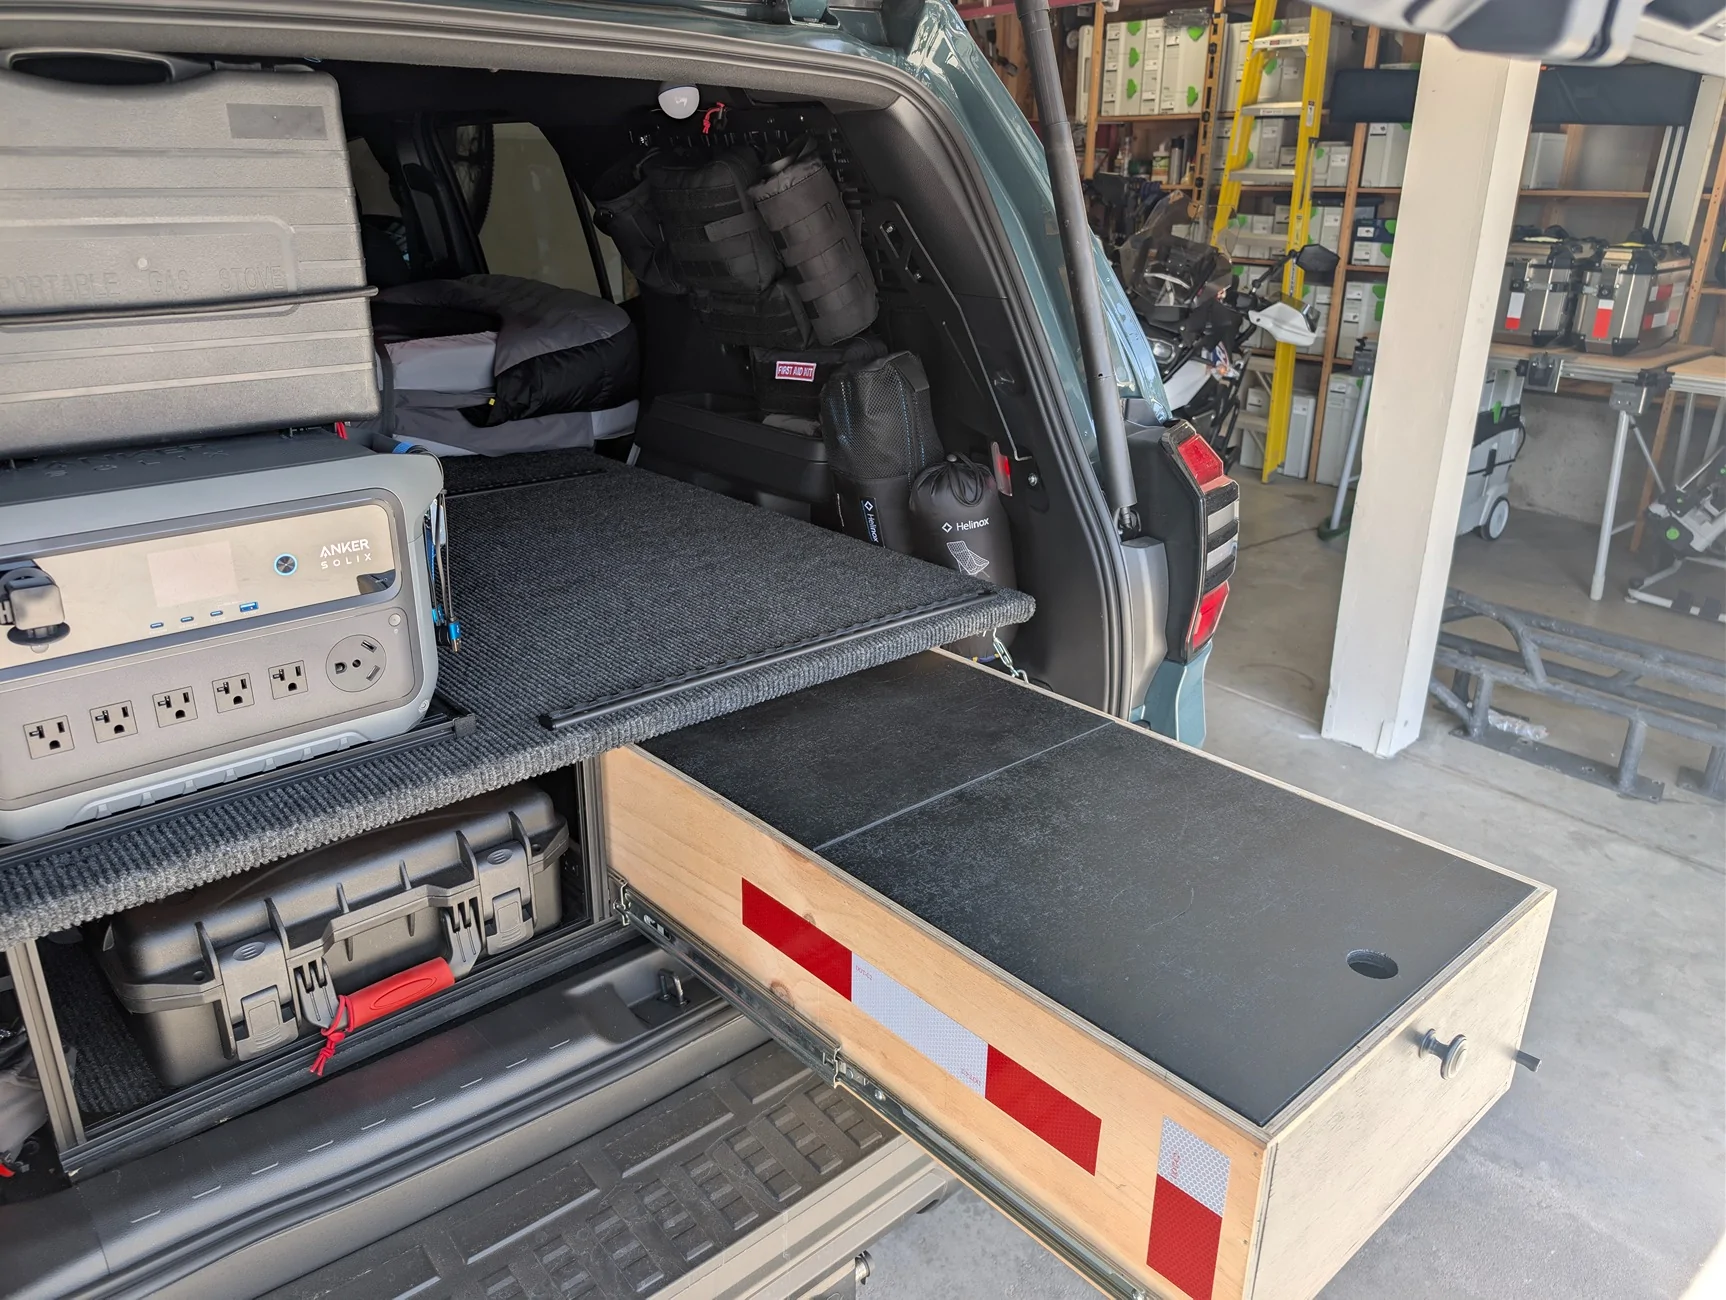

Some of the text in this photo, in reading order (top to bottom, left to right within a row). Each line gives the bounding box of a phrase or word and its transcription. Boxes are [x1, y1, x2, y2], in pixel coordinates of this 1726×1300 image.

[0, 265, 285, 303] PORTABLE GAS STOVE
[778, 365, 793, 375] FIRST
[793, 366, 803, 376] AID
[867, 513, 879, 543] Helinox
[956, 517, 990, 531] Helinox
[320, 538, 370, 558] ANKER
[320, 552, 372, 570] SOLIX
